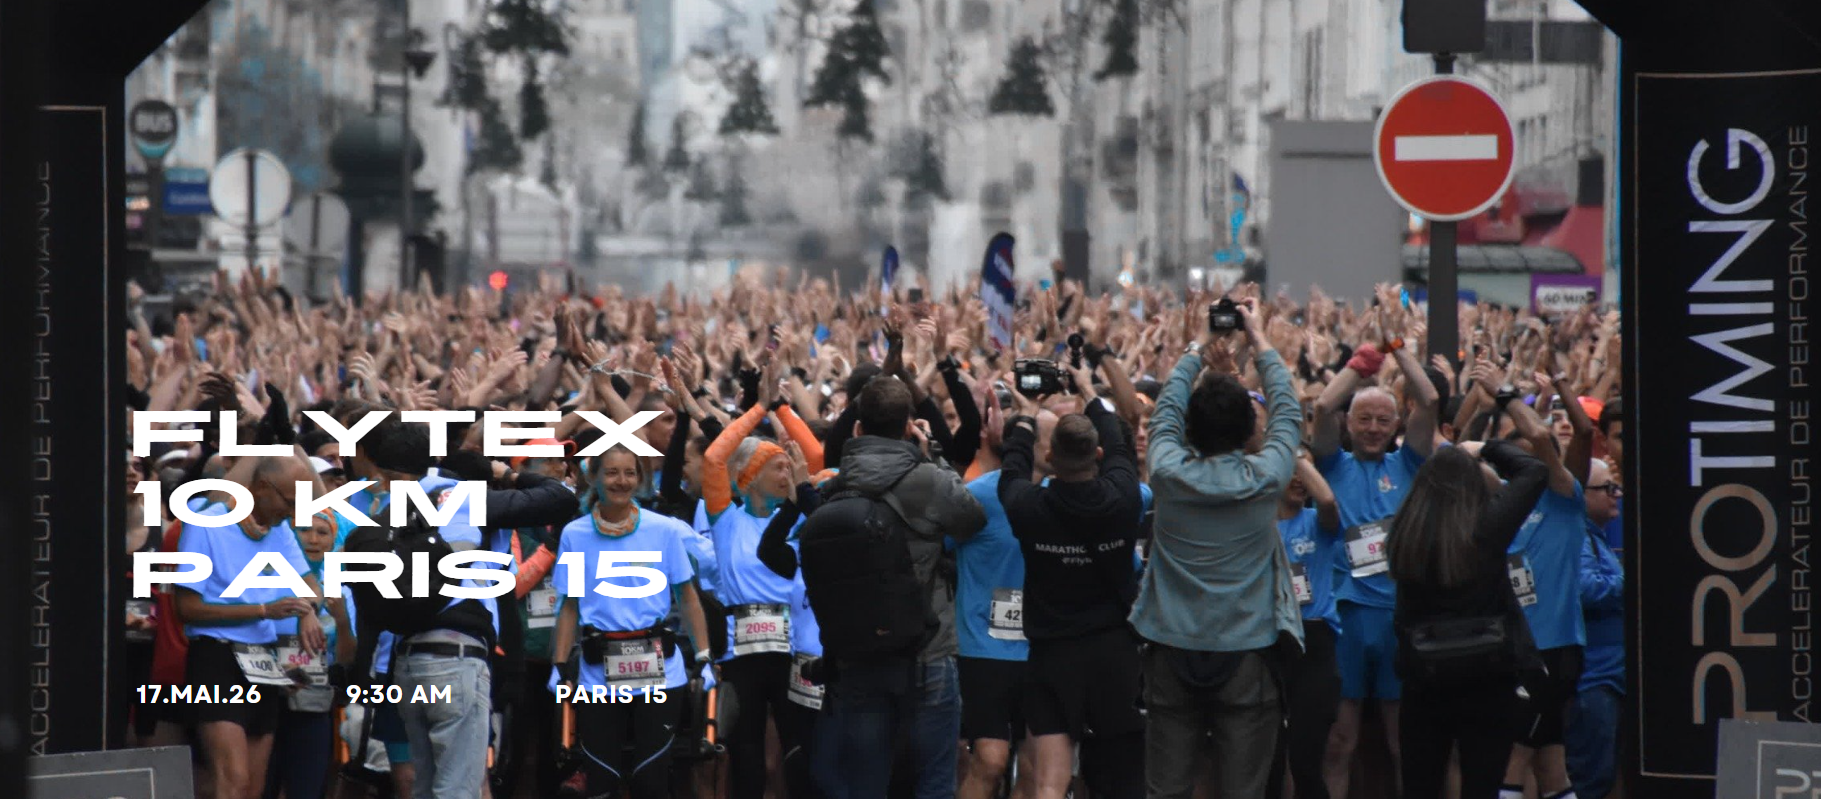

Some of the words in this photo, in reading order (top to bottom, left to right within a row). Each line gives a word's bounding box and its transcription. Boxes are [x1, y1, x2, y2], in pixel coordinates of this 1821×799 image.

[135, 110, 173, 133] BUS
[1788, 125, 1809, 388] PERFORMANCE
[1687, 127, 1777, 724] PROTIMING
[1789, 401, 1809, 445] DE
[33, 436, 50, 481] DE
[1035, 543, 1088, 554] MARATHO
[1790, 458, 1812, 723] ACCELERATEUR
[745, 621, 776, 635] 2095
[1004, 609, 1022, 621] 42
[618, 660, 650, 674] 5197
